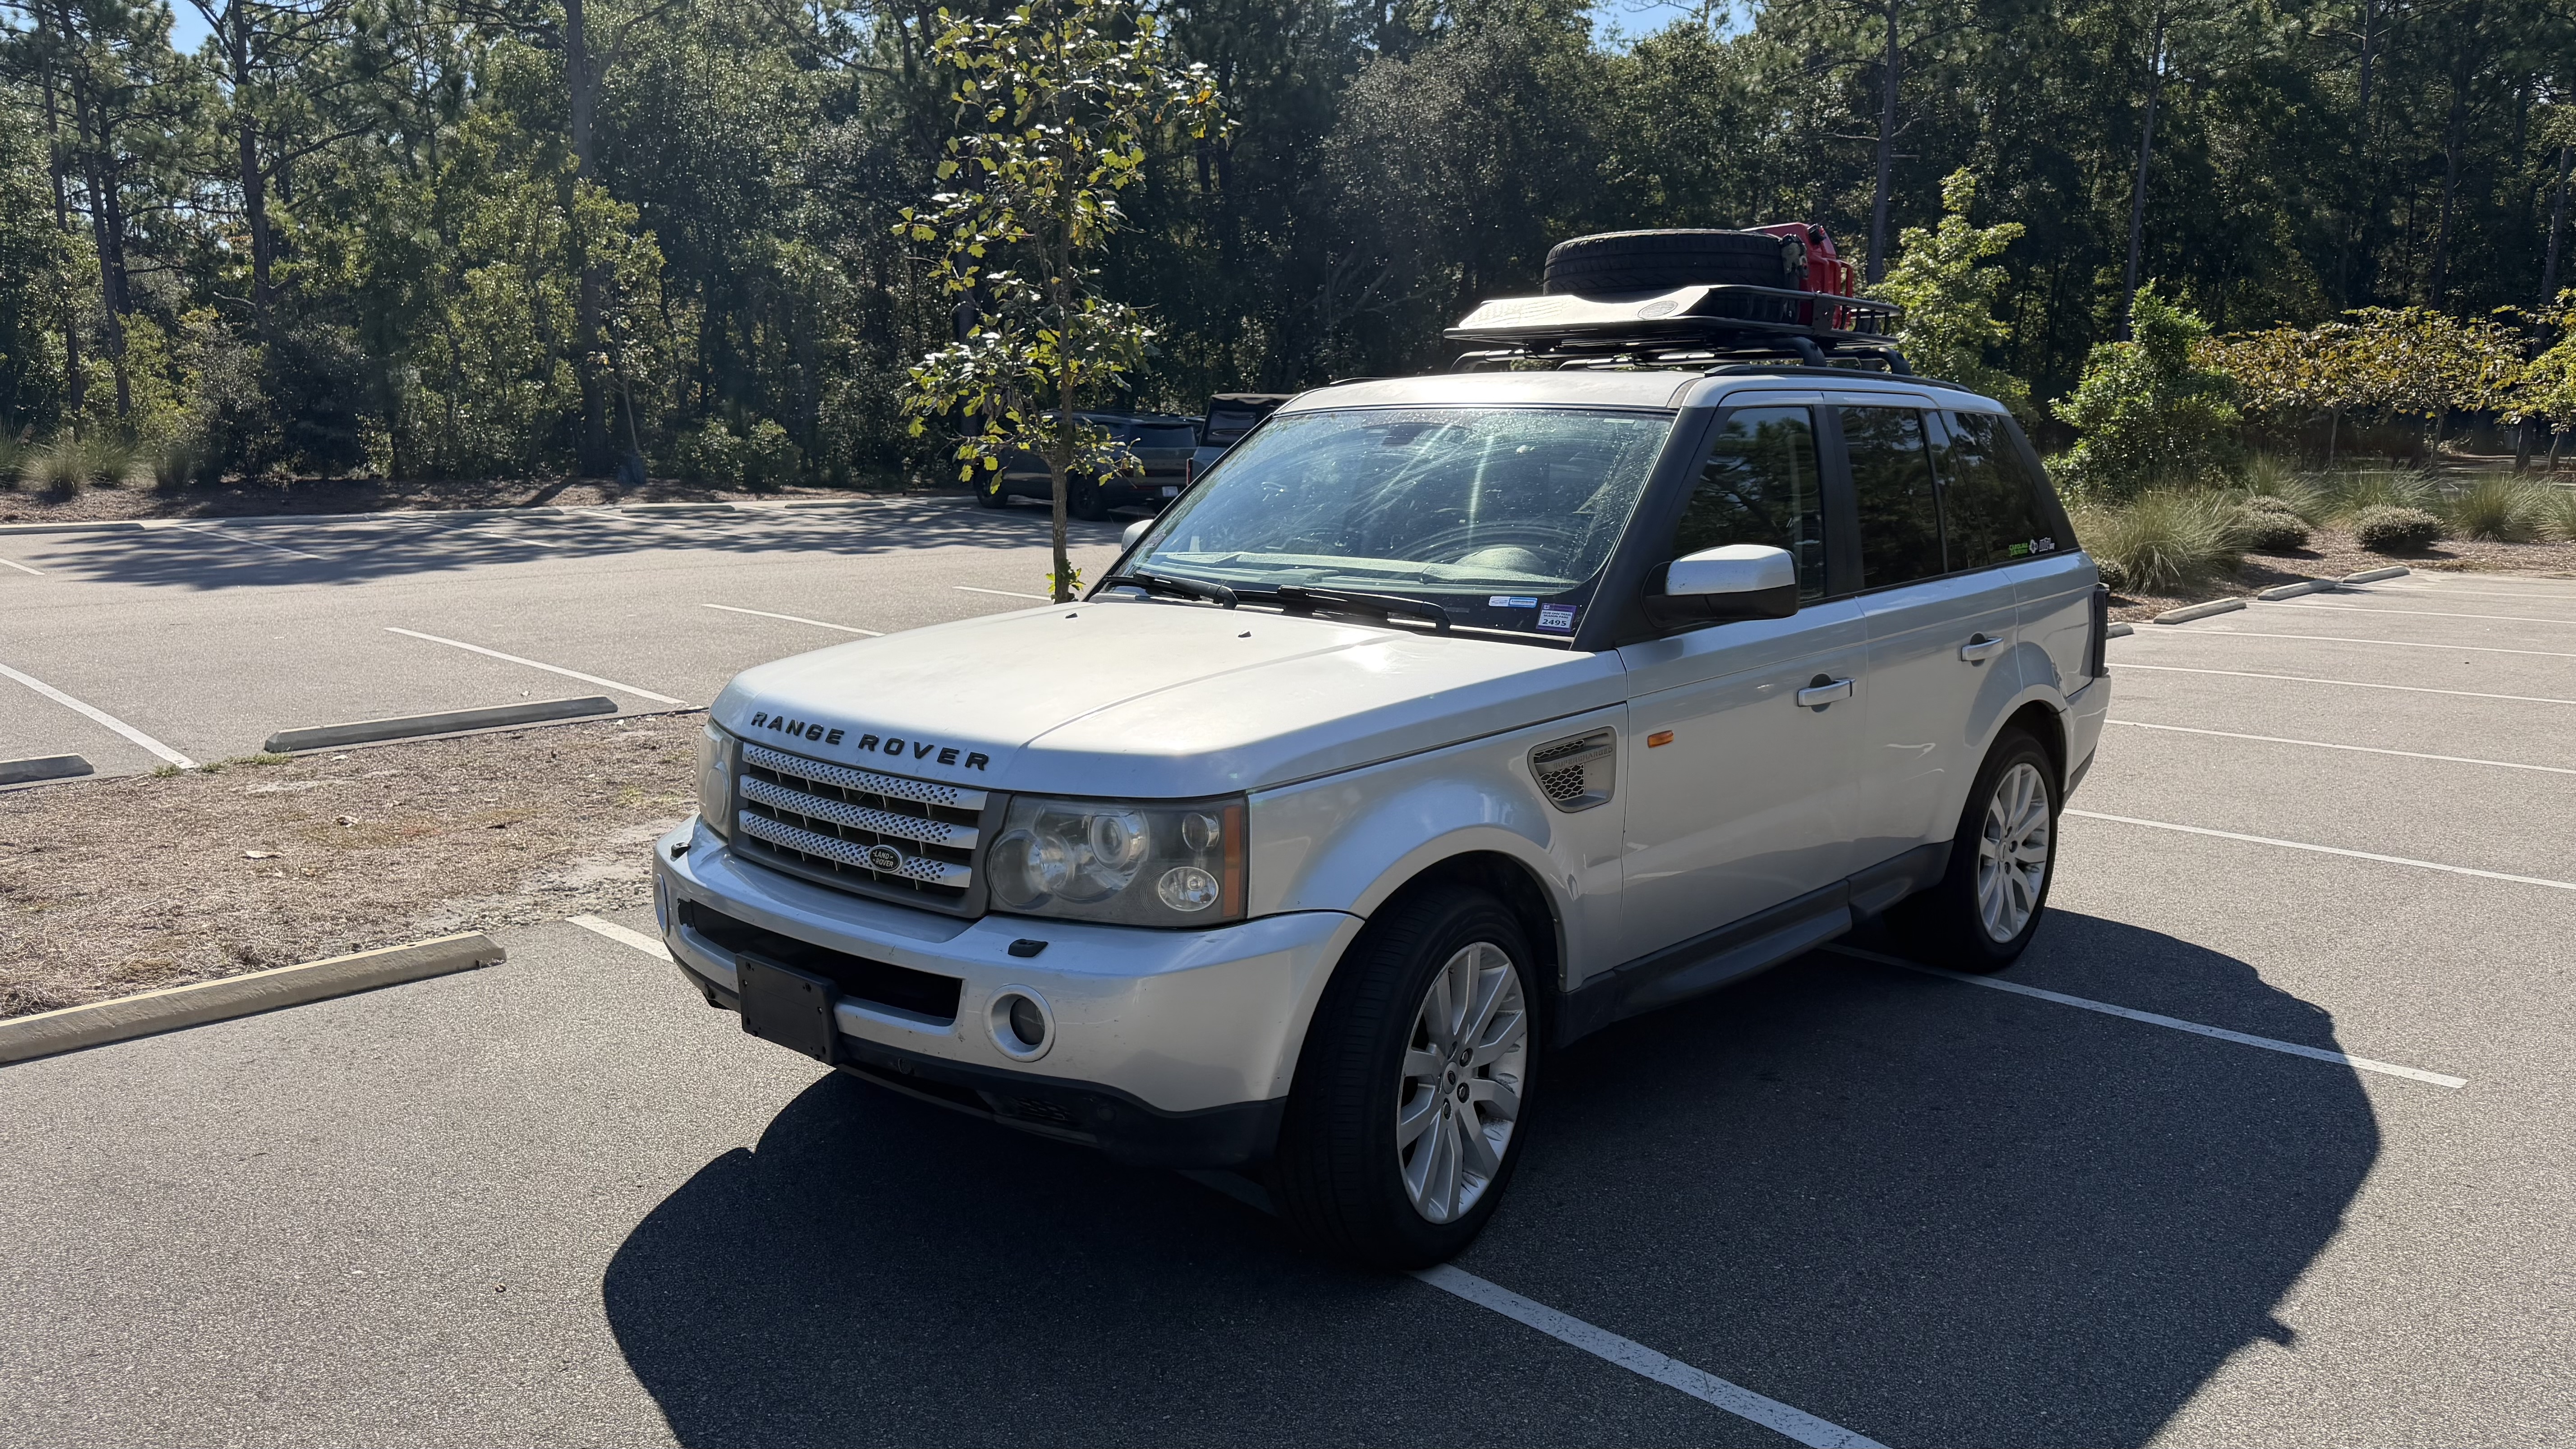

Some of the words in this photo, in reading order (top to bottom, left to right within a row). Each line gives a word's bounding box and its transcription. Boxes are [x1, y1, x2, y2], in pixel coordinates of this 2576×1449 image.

[750, 711, 845, 745] RANGE
[858, 733, 989, 771] ROVER
[1553, 746, 1613, 769] SUPERCHARGED
[874, 850, 890, 860] LAND
[875, 858, 894, 868] ROVER
